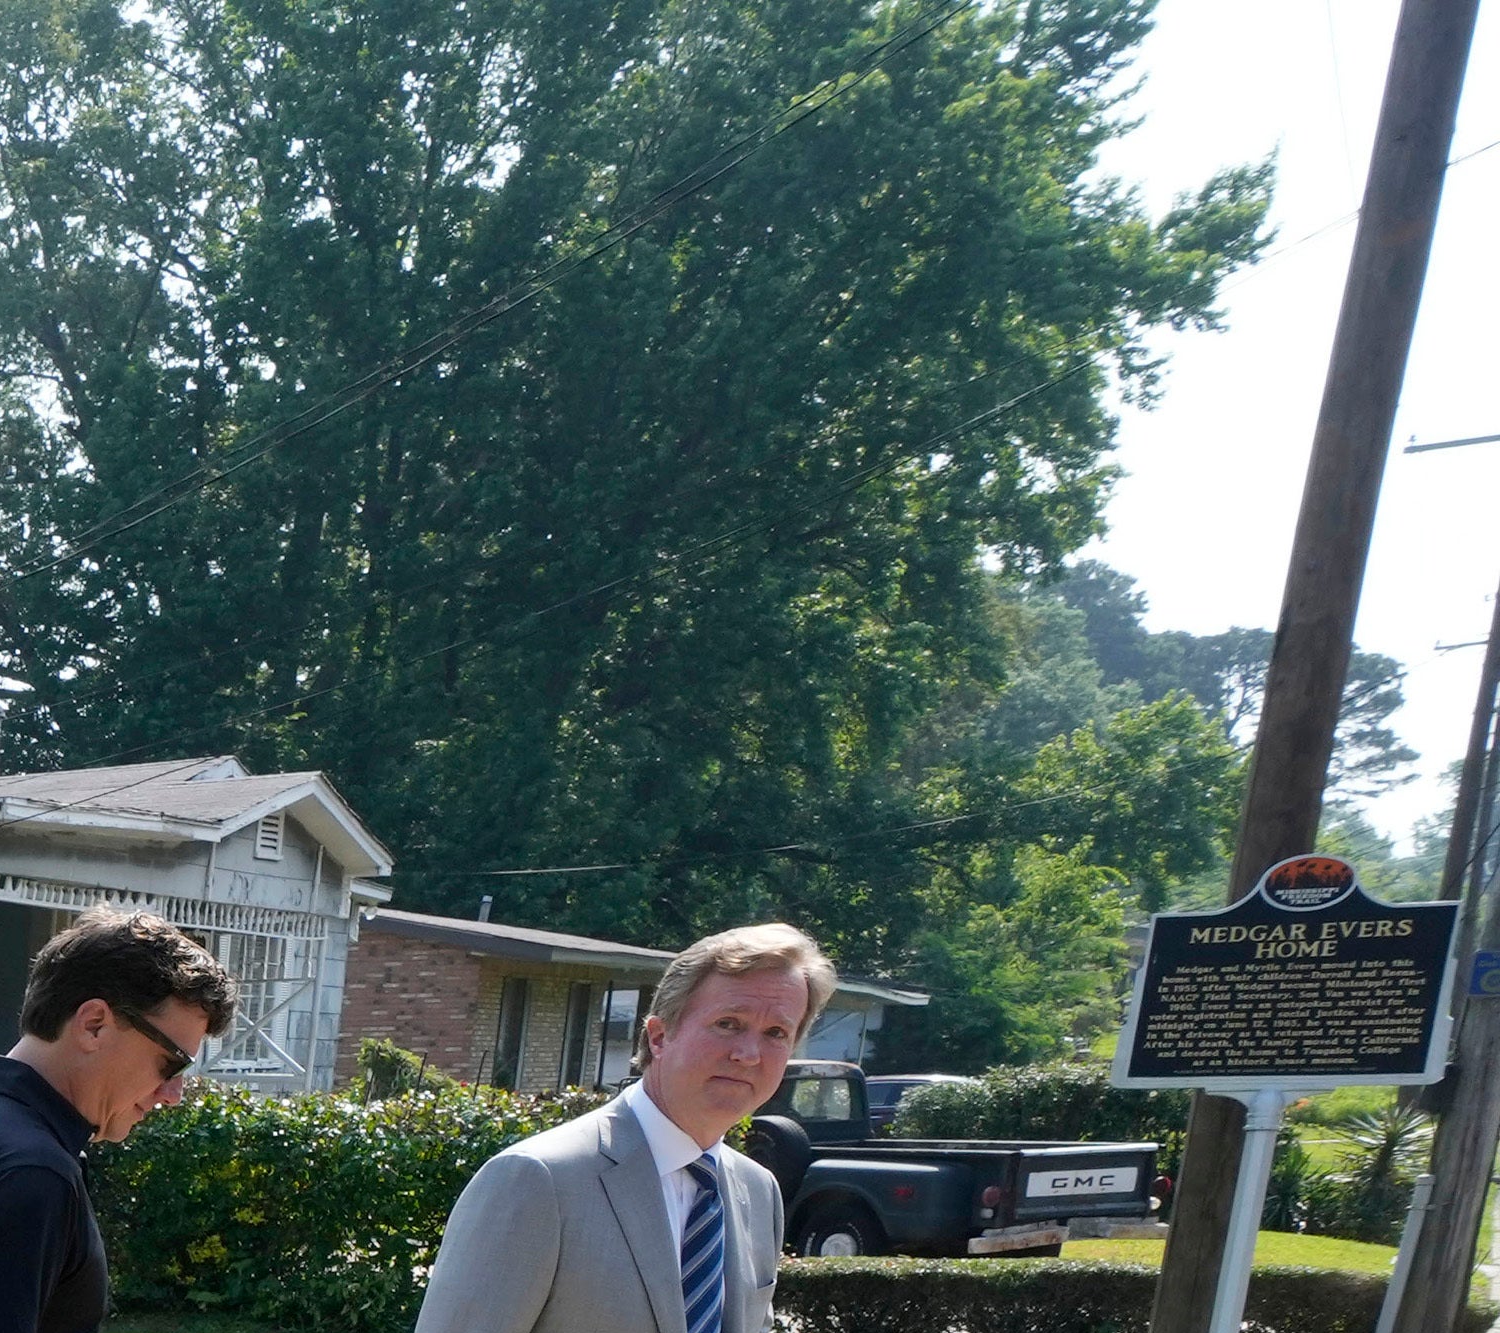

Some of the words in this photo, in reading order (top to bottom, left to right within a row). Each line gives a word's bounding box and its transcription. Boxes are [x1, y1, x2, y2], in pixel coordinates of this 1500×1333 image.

[1189, 923, 1307, 944] MEDGAR
[1319, 919, 1413, 939] EVERS
[1254, 940, 1338, 959] HOME
[1176, 966, 1215, 975] Medgar
[1220, 964, 1240, 973] and
[1245, 963, 1281, 974] Myrlie
[1287, 962, 1316, 970] Evers
[1320, 961, 1357, 969] moved
[1361, 960, 1386, 968] into
[1391, 959, 1414, 967] this
[1161, 976, 1191, 984] home
[1224, 974, 1252, 982] their
[1355, 969, 1378, 978] and
[1157, 985, 1169, 993] in
[1201, 983, 1231, 992] after
[1234, 982, 1275, 992] Medgar
[1279, 981, 1321, 989] became
[1398, 977, 1426, 986] first
[1160, 993, 1200, 1003] NAACP
[1204, 992, 1232, 1001] Field
[1298, 990, 1320, 998] Son
[1325, 990, 1345, 998] Van
[1374, 989, 1403, 997] born
[1407, 988, 1420, 996] in
[1201, 1002, 1230, 1010] Evers
[1276, 1000, 1333, 1010] outspoken
[1337, 999, 1382, 1007] activist
[1386, 998, 1406, 1006] for
[1182, 1010, 1247, 1021] registration
[1251, 1010, 1273, 1019] and
[1277, 1009, 1311, 1018] social
[1364, 1007, 1390, 1016] Just
[1394, 1007, 1427, 1015] after
[1222, 1020, 1248, 1029] June
[1305, 1018, 1321, 1027] he
[1350, 1017, 1423, 1026] assassinated
[1146, 1031, 1158, 1040] in
[1162, 1031, 1181, 1039] the
[1185, 1030, 1235, 1039] driveway
[1255, 1029, 1269, 1037] he
[1274, 1028, 1324, 1037] returned
[1328, 1027, 1357, 1036] from
[1143, 1040, 1175, 1049] After
[1176, 1039, 1194, 1048] his
[1238, 1038, 1257, 1047] the
[1261, 1037, 1298, 1047] family
[1302, 1037, 1339, 1046] moved
[1343, 1037, 1358, 1045] to
[1361, 1035, 1420, 1045] California
[1157, 1049, 1177, 1058] and
[1180, 1048, 1220, 1057] deeded
[1224, 1047, 1243, 1056] the
[1248, 1047, 1279, 1056] home
[1282, 1047, 1297, 1056] to
[1302, 1046, 1355, 1056] Tougaloo
[1358, 1045, 1401, 1055] College
[1192, 1059, 1205, 1067] as
[1227, 1057, 1270, 1067] historic
[1274, 1057, 1307, 1065] house
[1051, 1175, 1116, 1189] GMC
